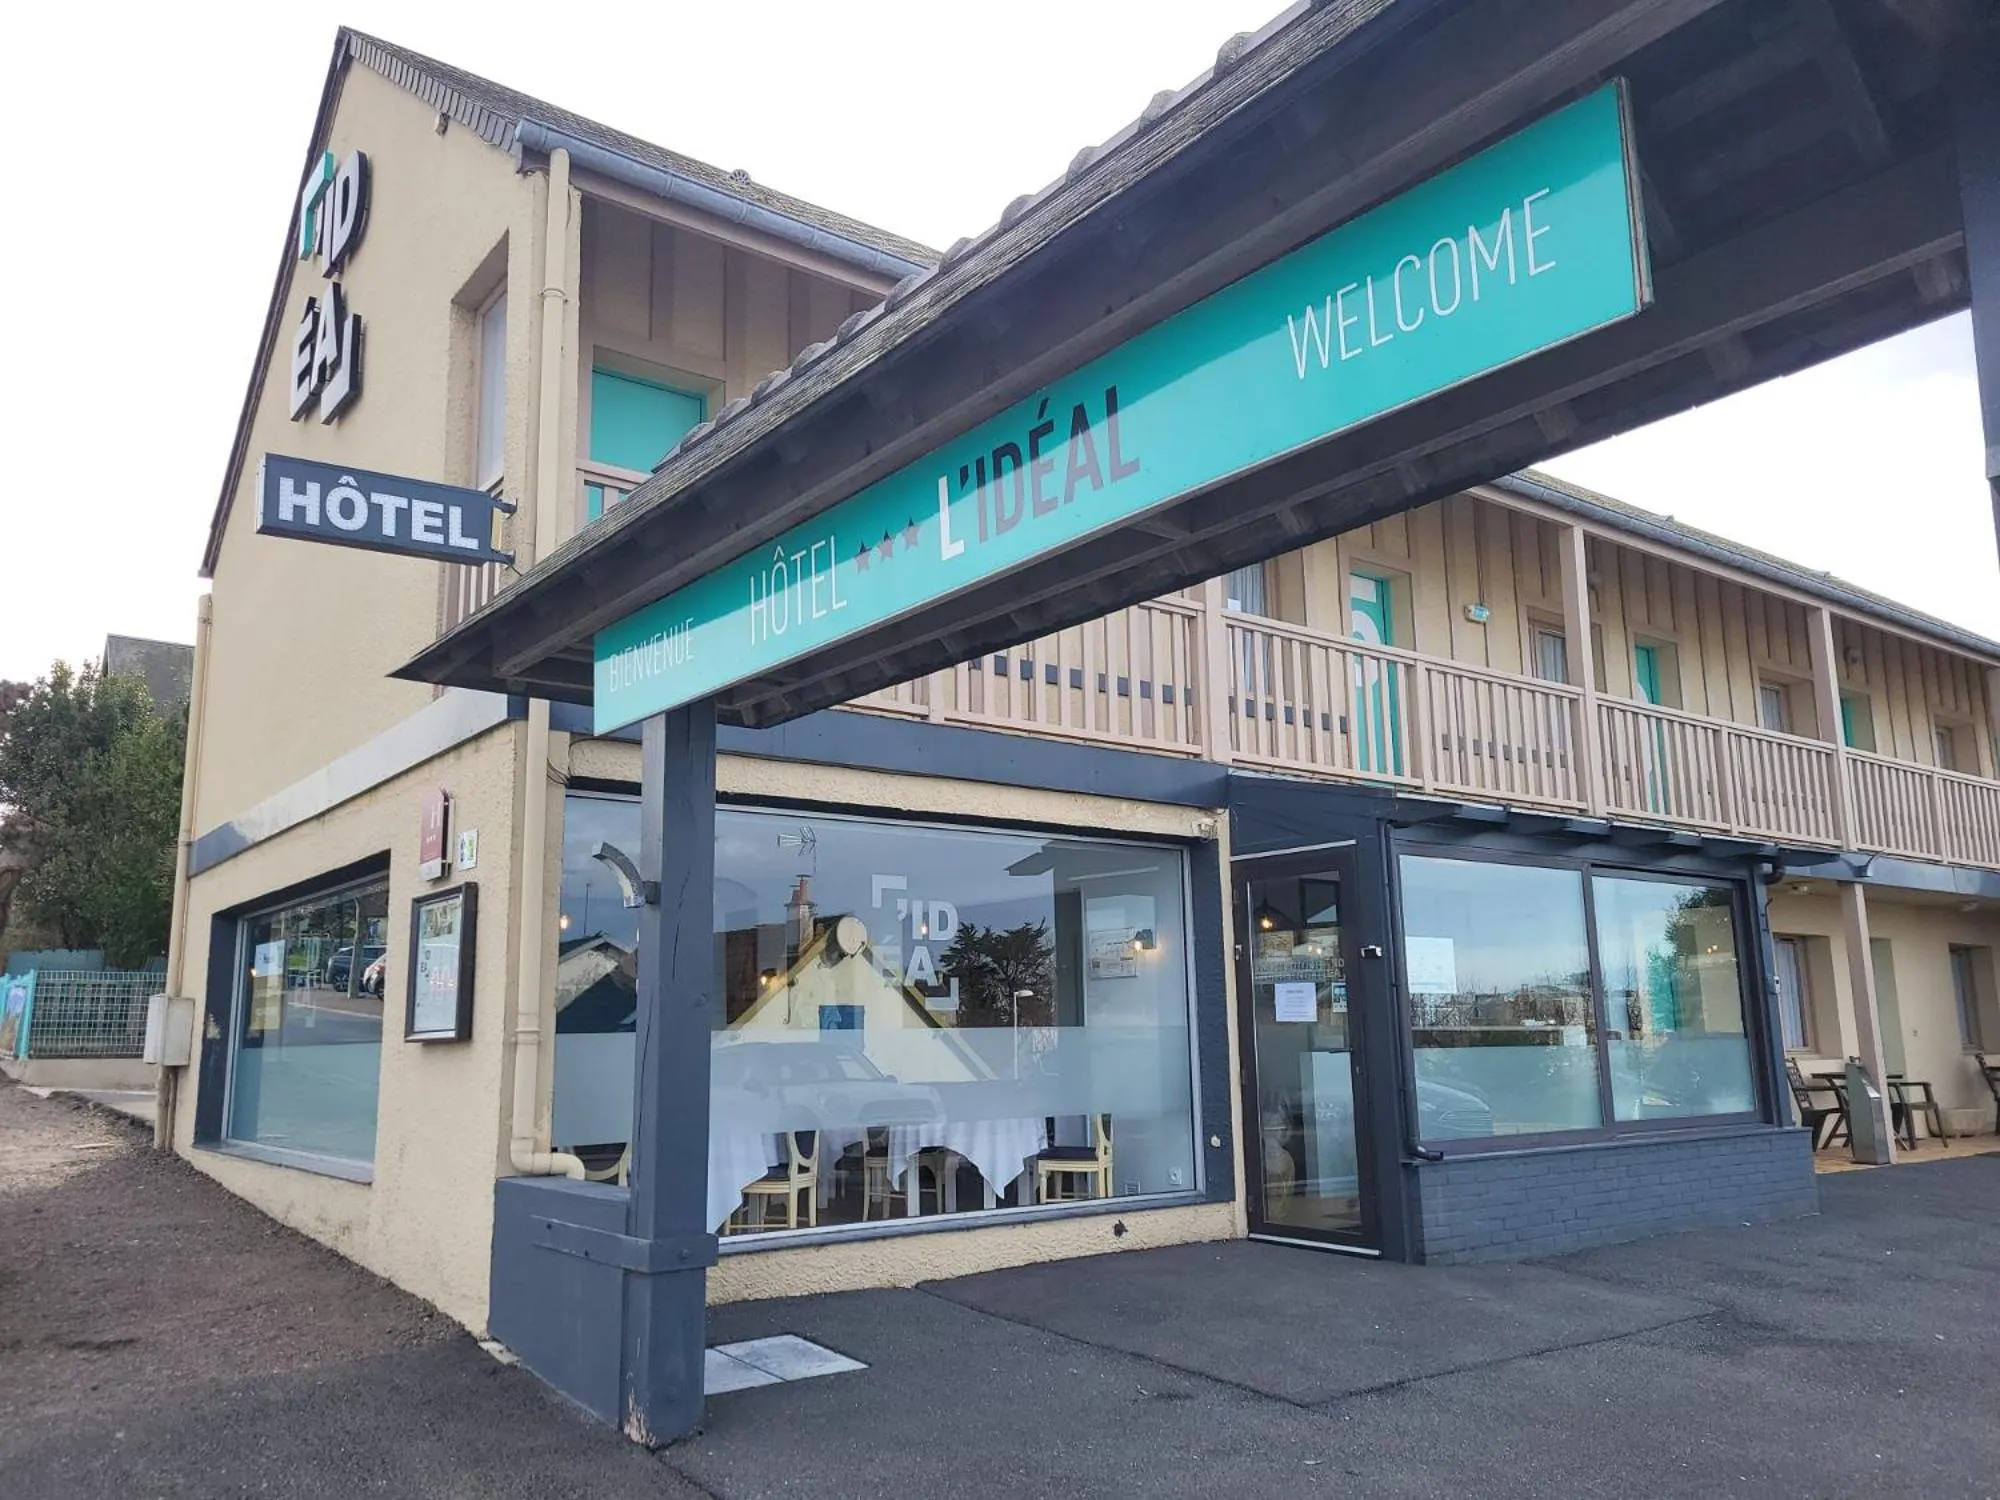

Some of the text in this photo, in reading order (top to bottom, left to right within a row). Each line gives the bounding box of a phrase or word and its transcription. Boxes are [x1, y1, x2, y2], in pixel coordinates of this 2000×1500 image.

[278, 475, 480, 550] HÔTEL
[608, 186, 1557, 694] BIENVENUE HÔTEL L'IDÉAL WELCOME
